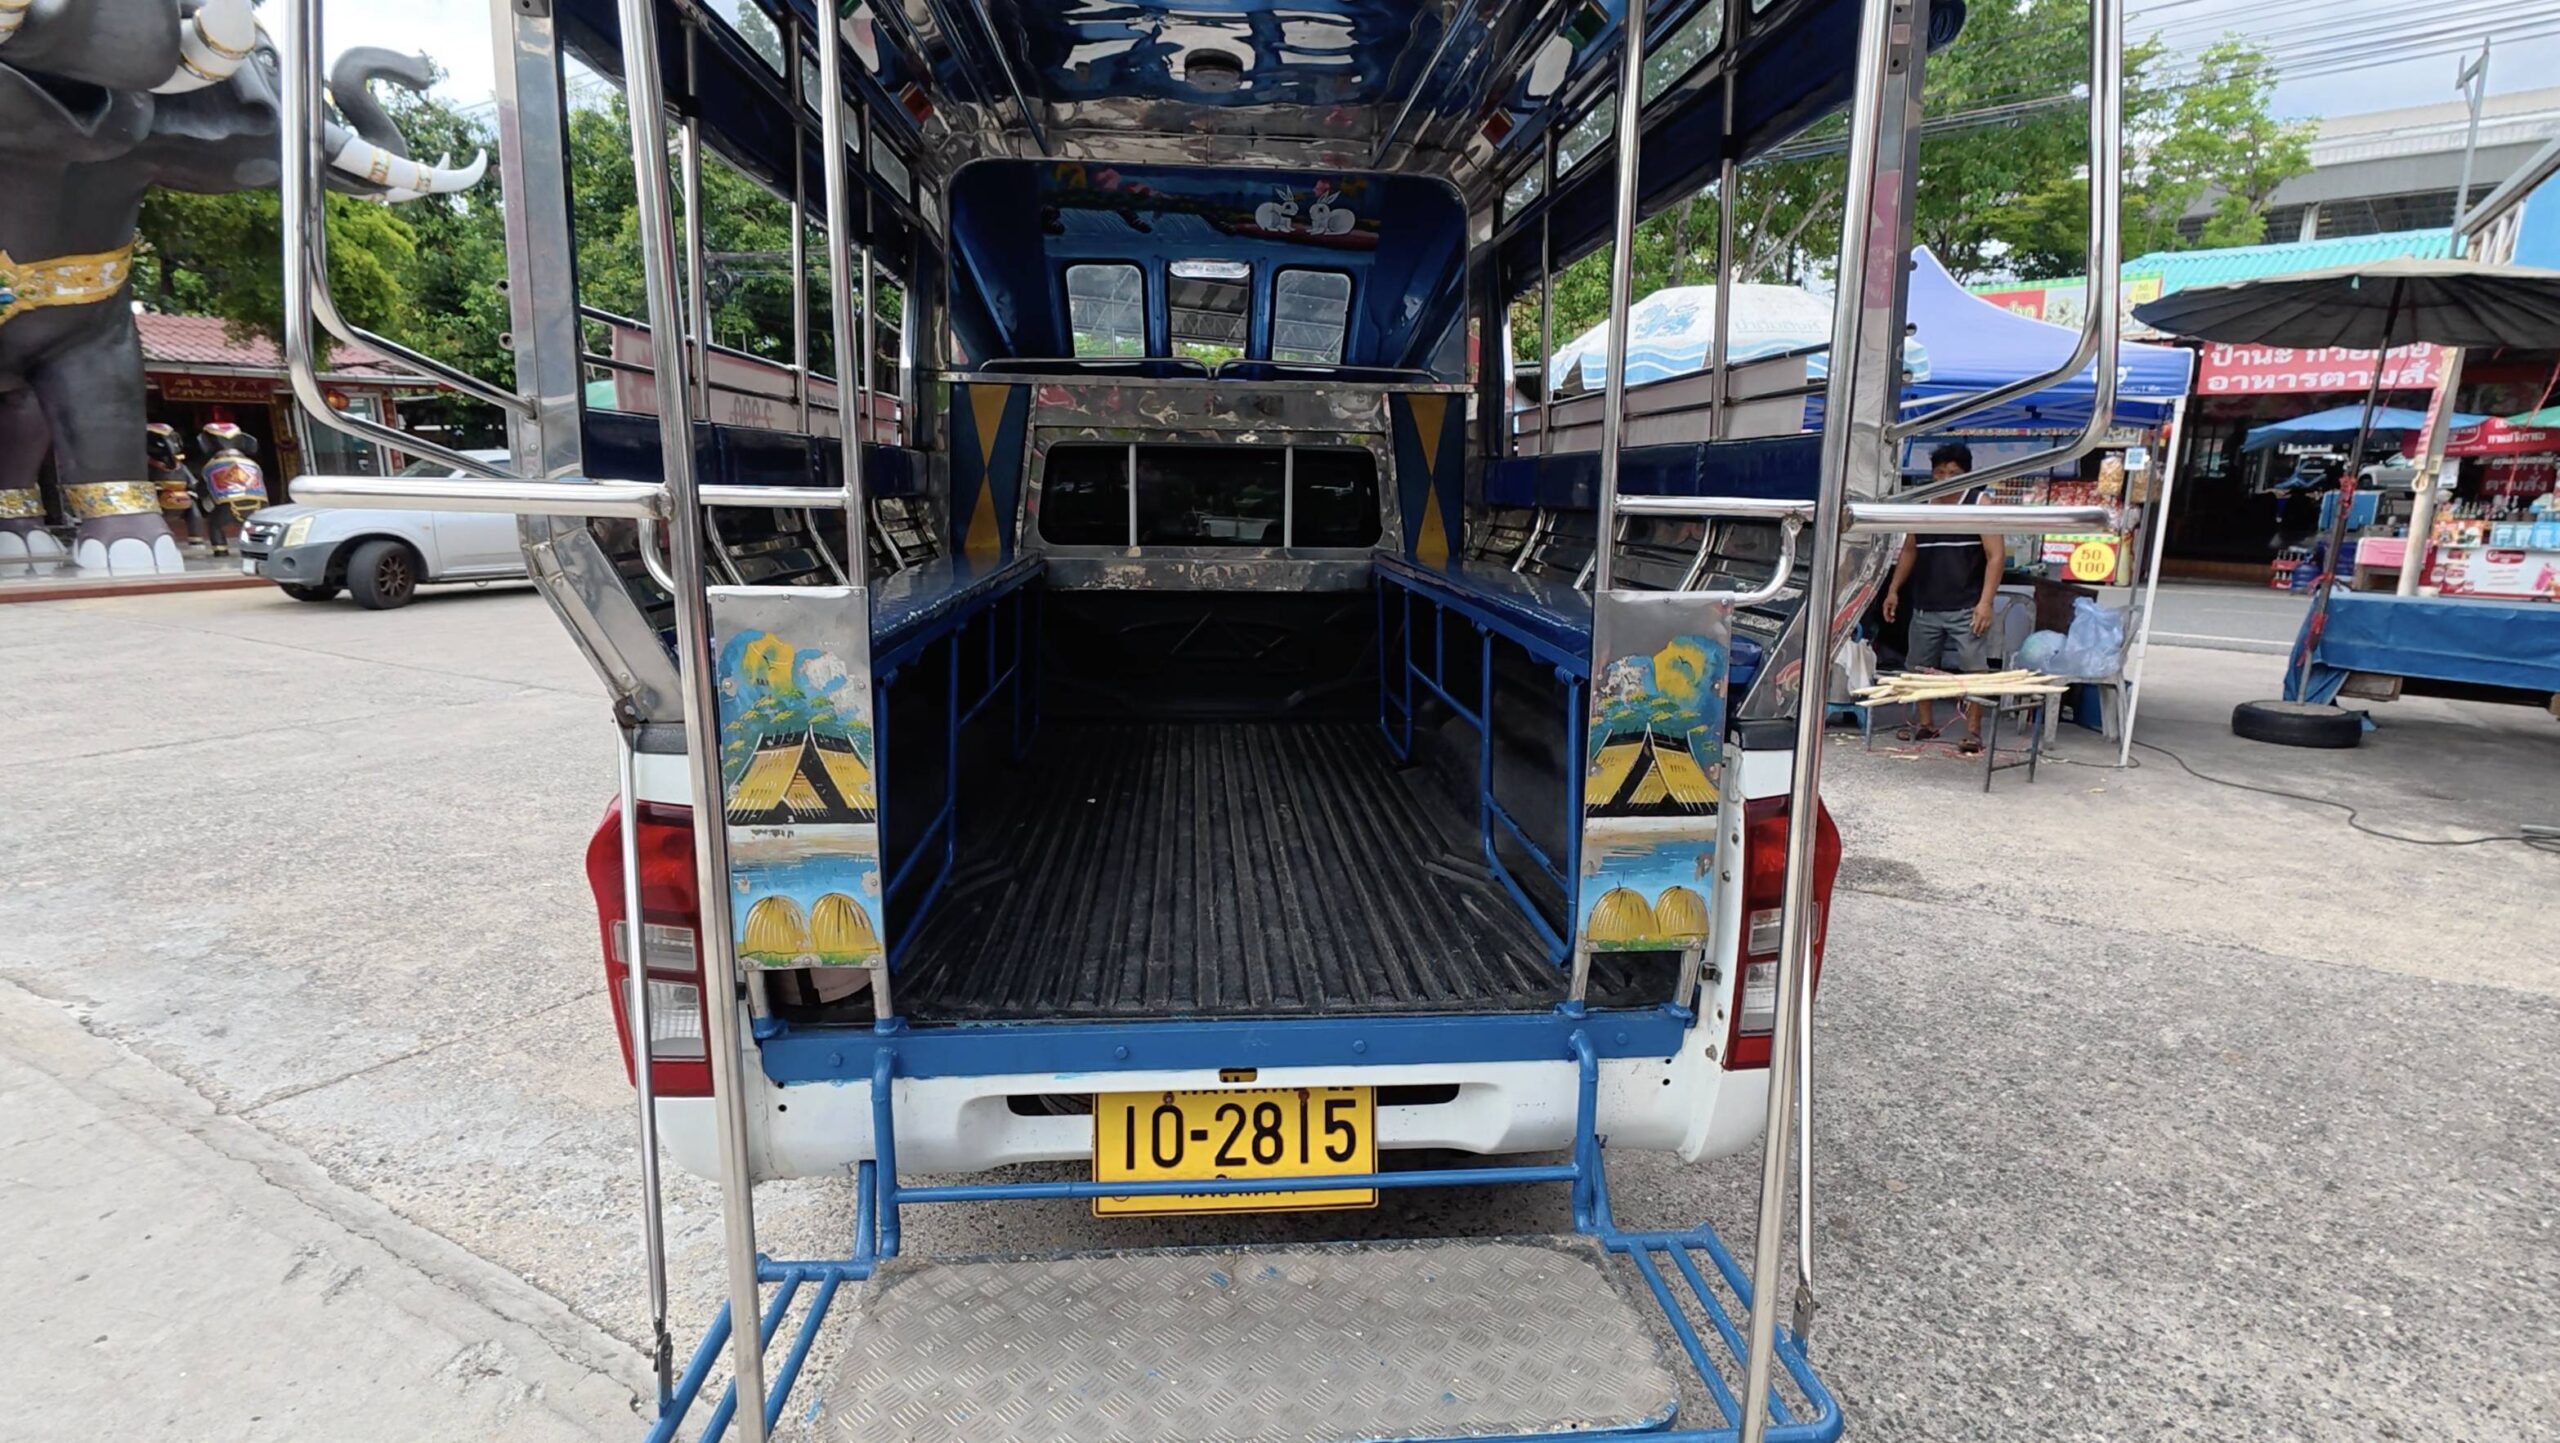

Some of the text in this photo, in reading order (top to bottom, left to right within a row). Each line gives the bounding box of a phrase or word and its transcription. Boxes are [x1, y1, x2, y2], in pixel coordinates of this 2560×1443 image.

[2081, 548, 2102, 561] 50
[2076, 561, 2106, 574] 100
[1125, 1098, 1357, 1171] 10-2815
